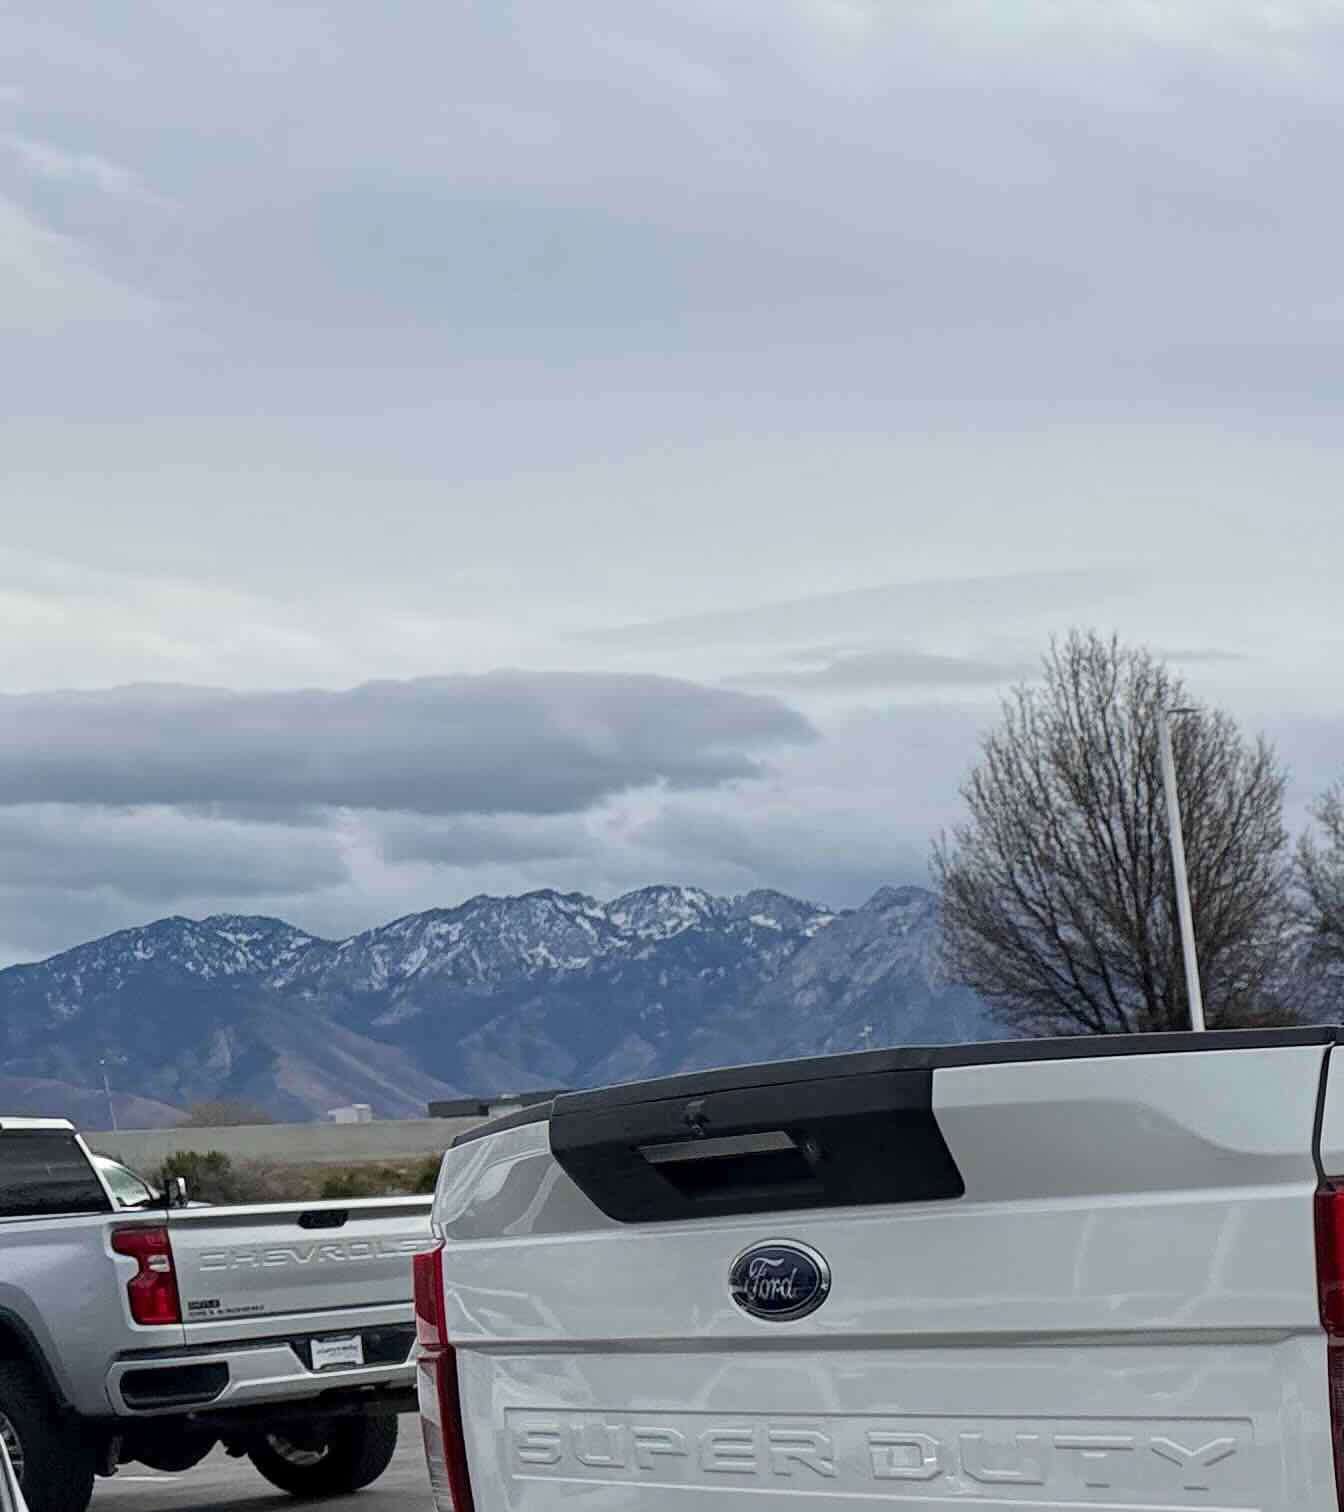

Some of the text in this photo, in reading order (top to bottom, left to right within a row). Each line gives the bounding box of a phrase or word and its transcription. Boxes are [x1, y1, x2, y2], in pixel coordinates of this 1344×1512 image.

[199, 1238, 430, 1271] CHEVROLE
[744, 1257, 798, 1300] Ford
[513, 1421, 1238, 1491] SUPER DUTY
